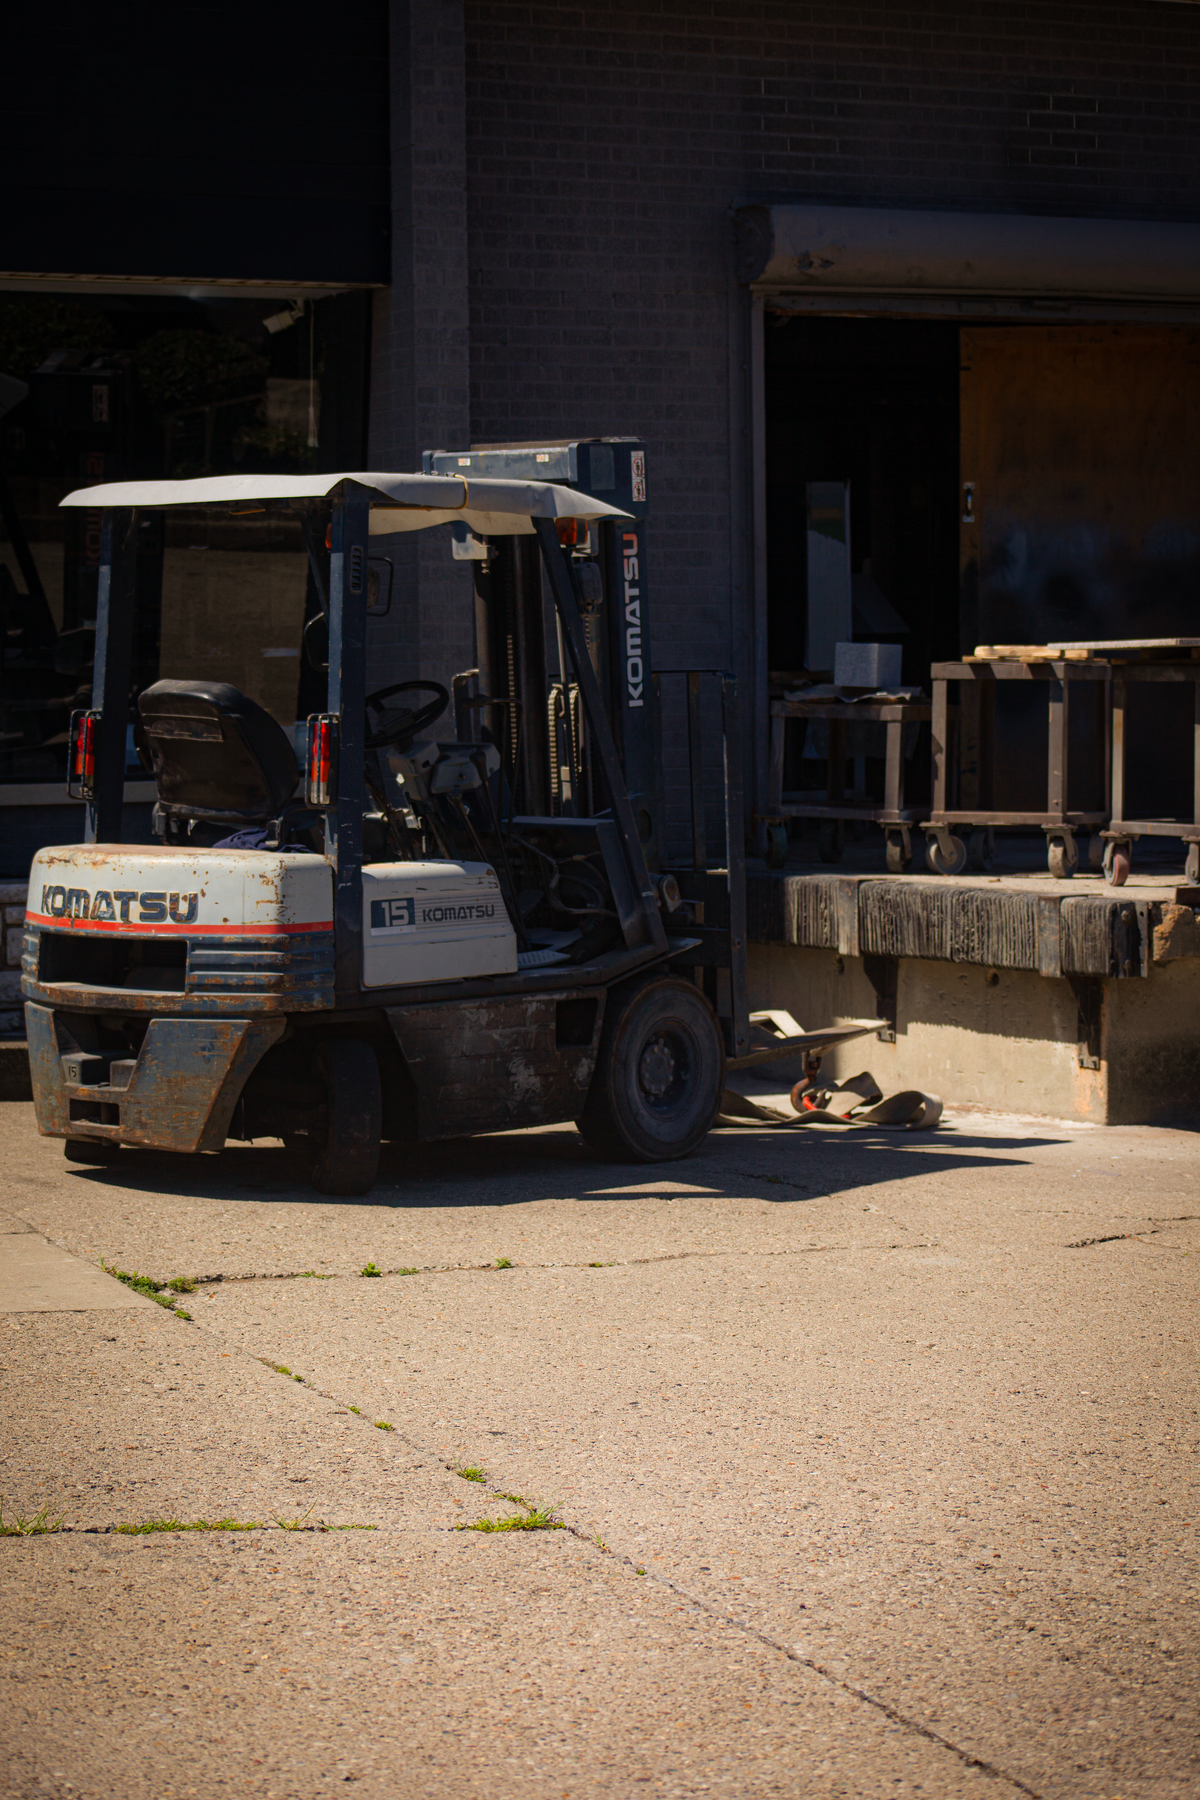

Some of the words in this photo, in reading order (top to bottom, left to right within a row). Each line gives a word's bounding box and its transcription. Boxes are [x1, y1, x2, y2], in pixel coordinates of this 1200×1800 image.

[622, 533, 644, 707] KOMATSU
[41, 884, 199, 923] KOMATSU
[381, 900, 410, 926] 15
[422, 904, 495, 922] KOMATSU
